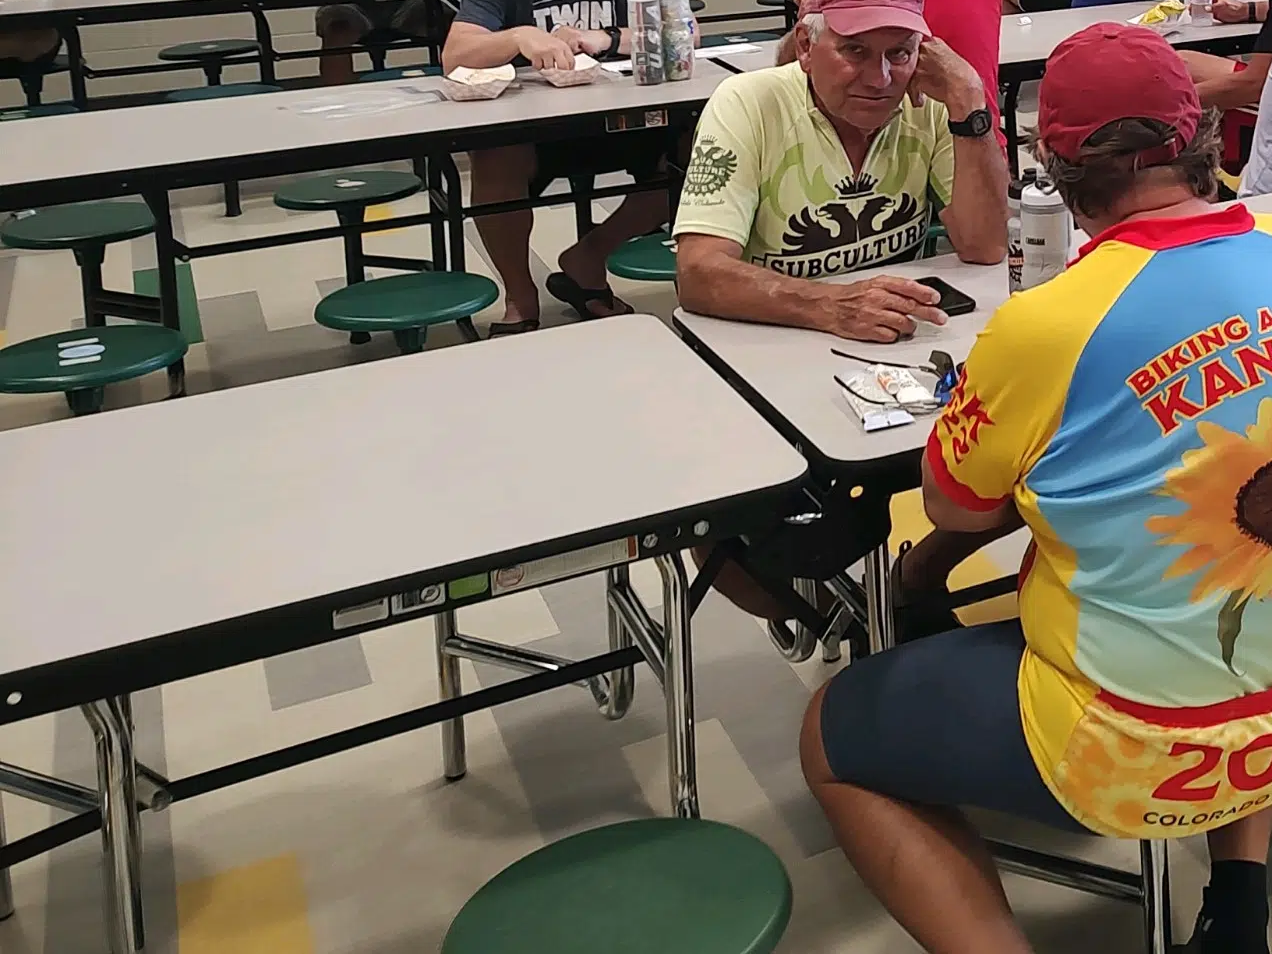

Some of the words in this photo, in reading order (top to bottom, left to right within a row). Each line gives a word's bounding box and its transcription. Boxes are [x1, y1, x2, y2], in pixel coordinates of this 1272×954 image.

[533, 0, 613, 32] TWIN
[771, 219, 927, 278] SUBCULTURE
[1126, 315, 1250, 399] BIKING
[1143, 793, 1271, 827] COLORADO
